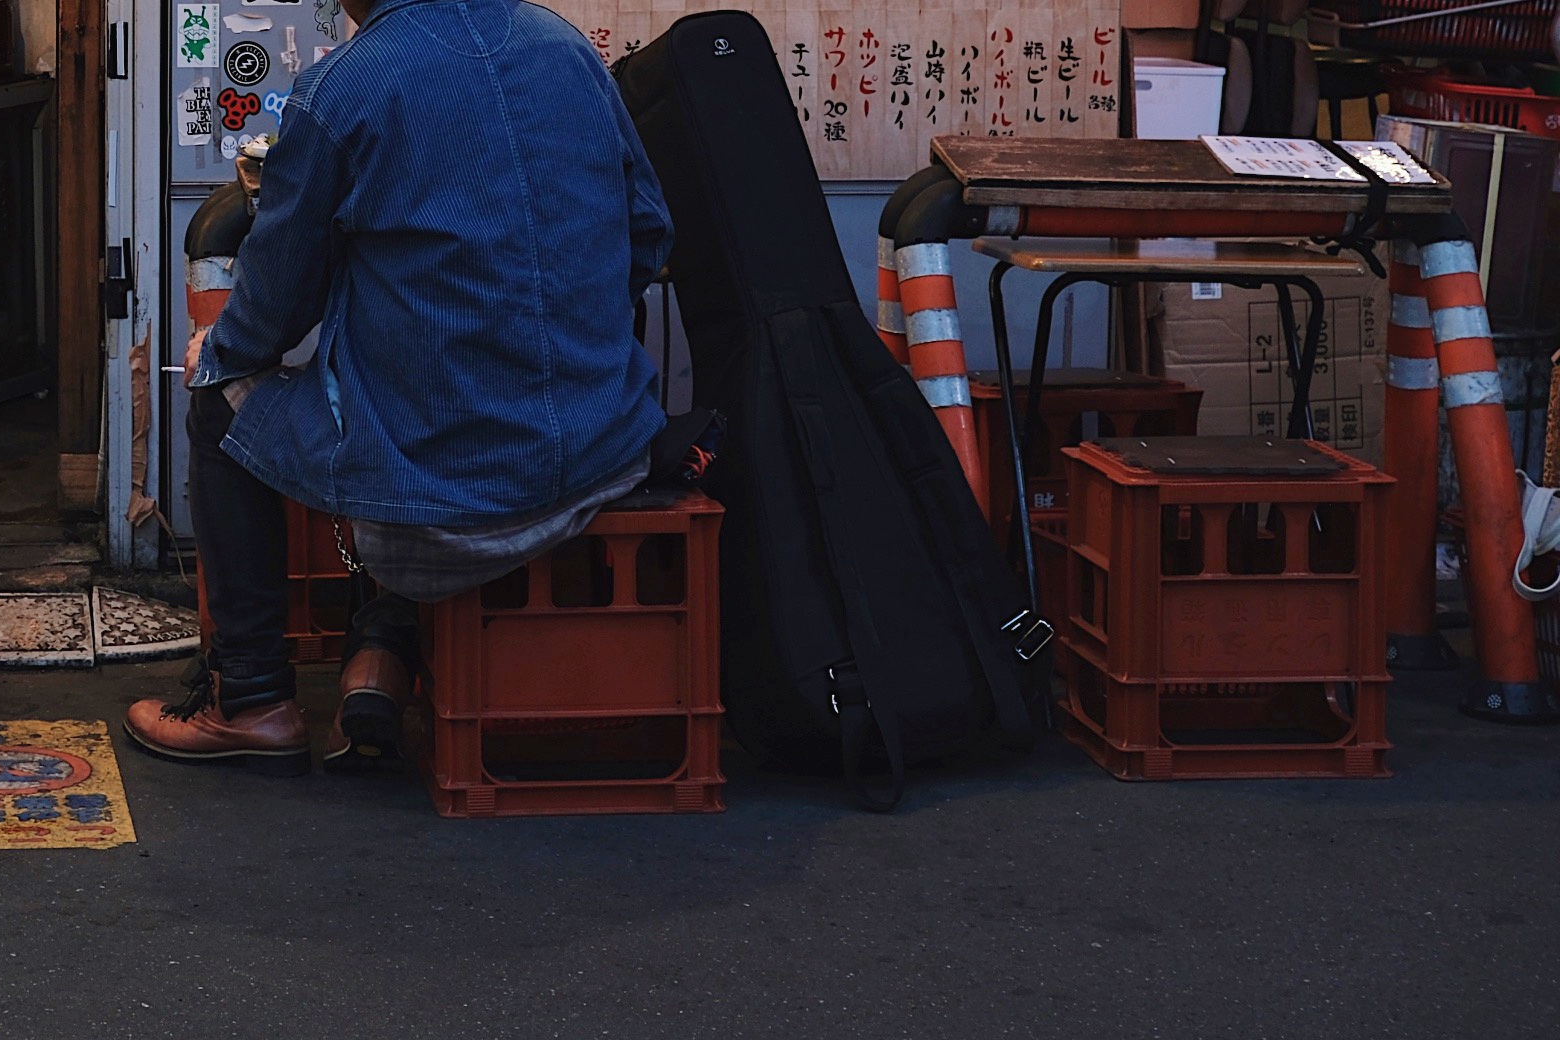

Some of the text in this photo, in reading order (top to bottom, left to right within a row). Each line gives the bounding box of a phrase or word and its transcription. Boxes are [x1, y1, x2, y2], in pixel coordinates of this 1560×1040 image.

[714, 48, 735, 56] SELVA
[824, 27, 848, 142] サワー 20種
[859, 28, 879, 118] ホッピー
[890, 43, 914, 130] 泡盛ハイ
[924, 40, 945, 125] 山崎ハイ
[960, 45, 979, 136] ハイボー
[991, 27, 1013, 127] ハイボール
[1023, 40, 1047, 123] 瓶ビール
[1057, 36, 1081, 123] 生ビール
[1088, 27, 1117, 112] ビール 各種
[1256, 335, 1272, 374] L-2
